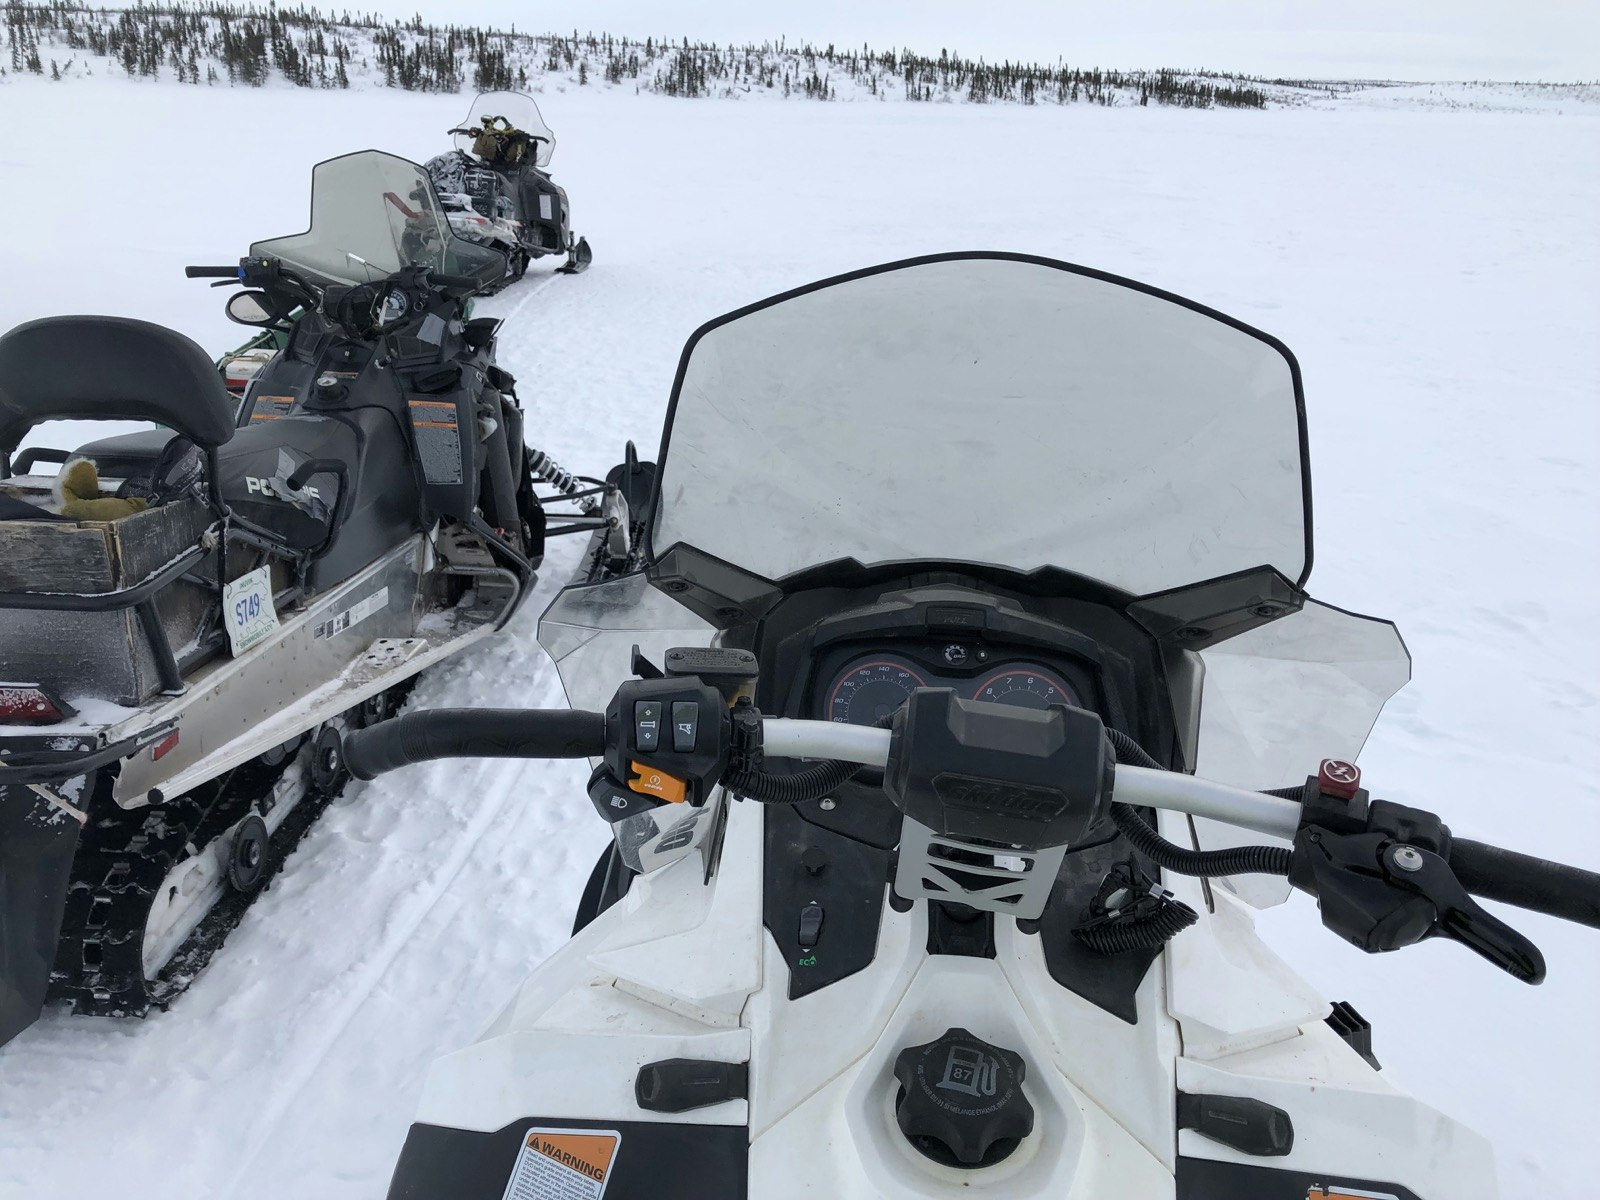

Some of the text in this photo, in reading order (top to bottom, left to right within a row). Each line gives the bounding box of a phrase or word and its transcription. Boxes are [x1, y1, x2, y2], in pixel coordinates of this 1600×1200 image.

[235, 593, 260, 626] S749
[953, 1068, 972, 1080] 87
[542, 1141, 604, 1181] WARNING
